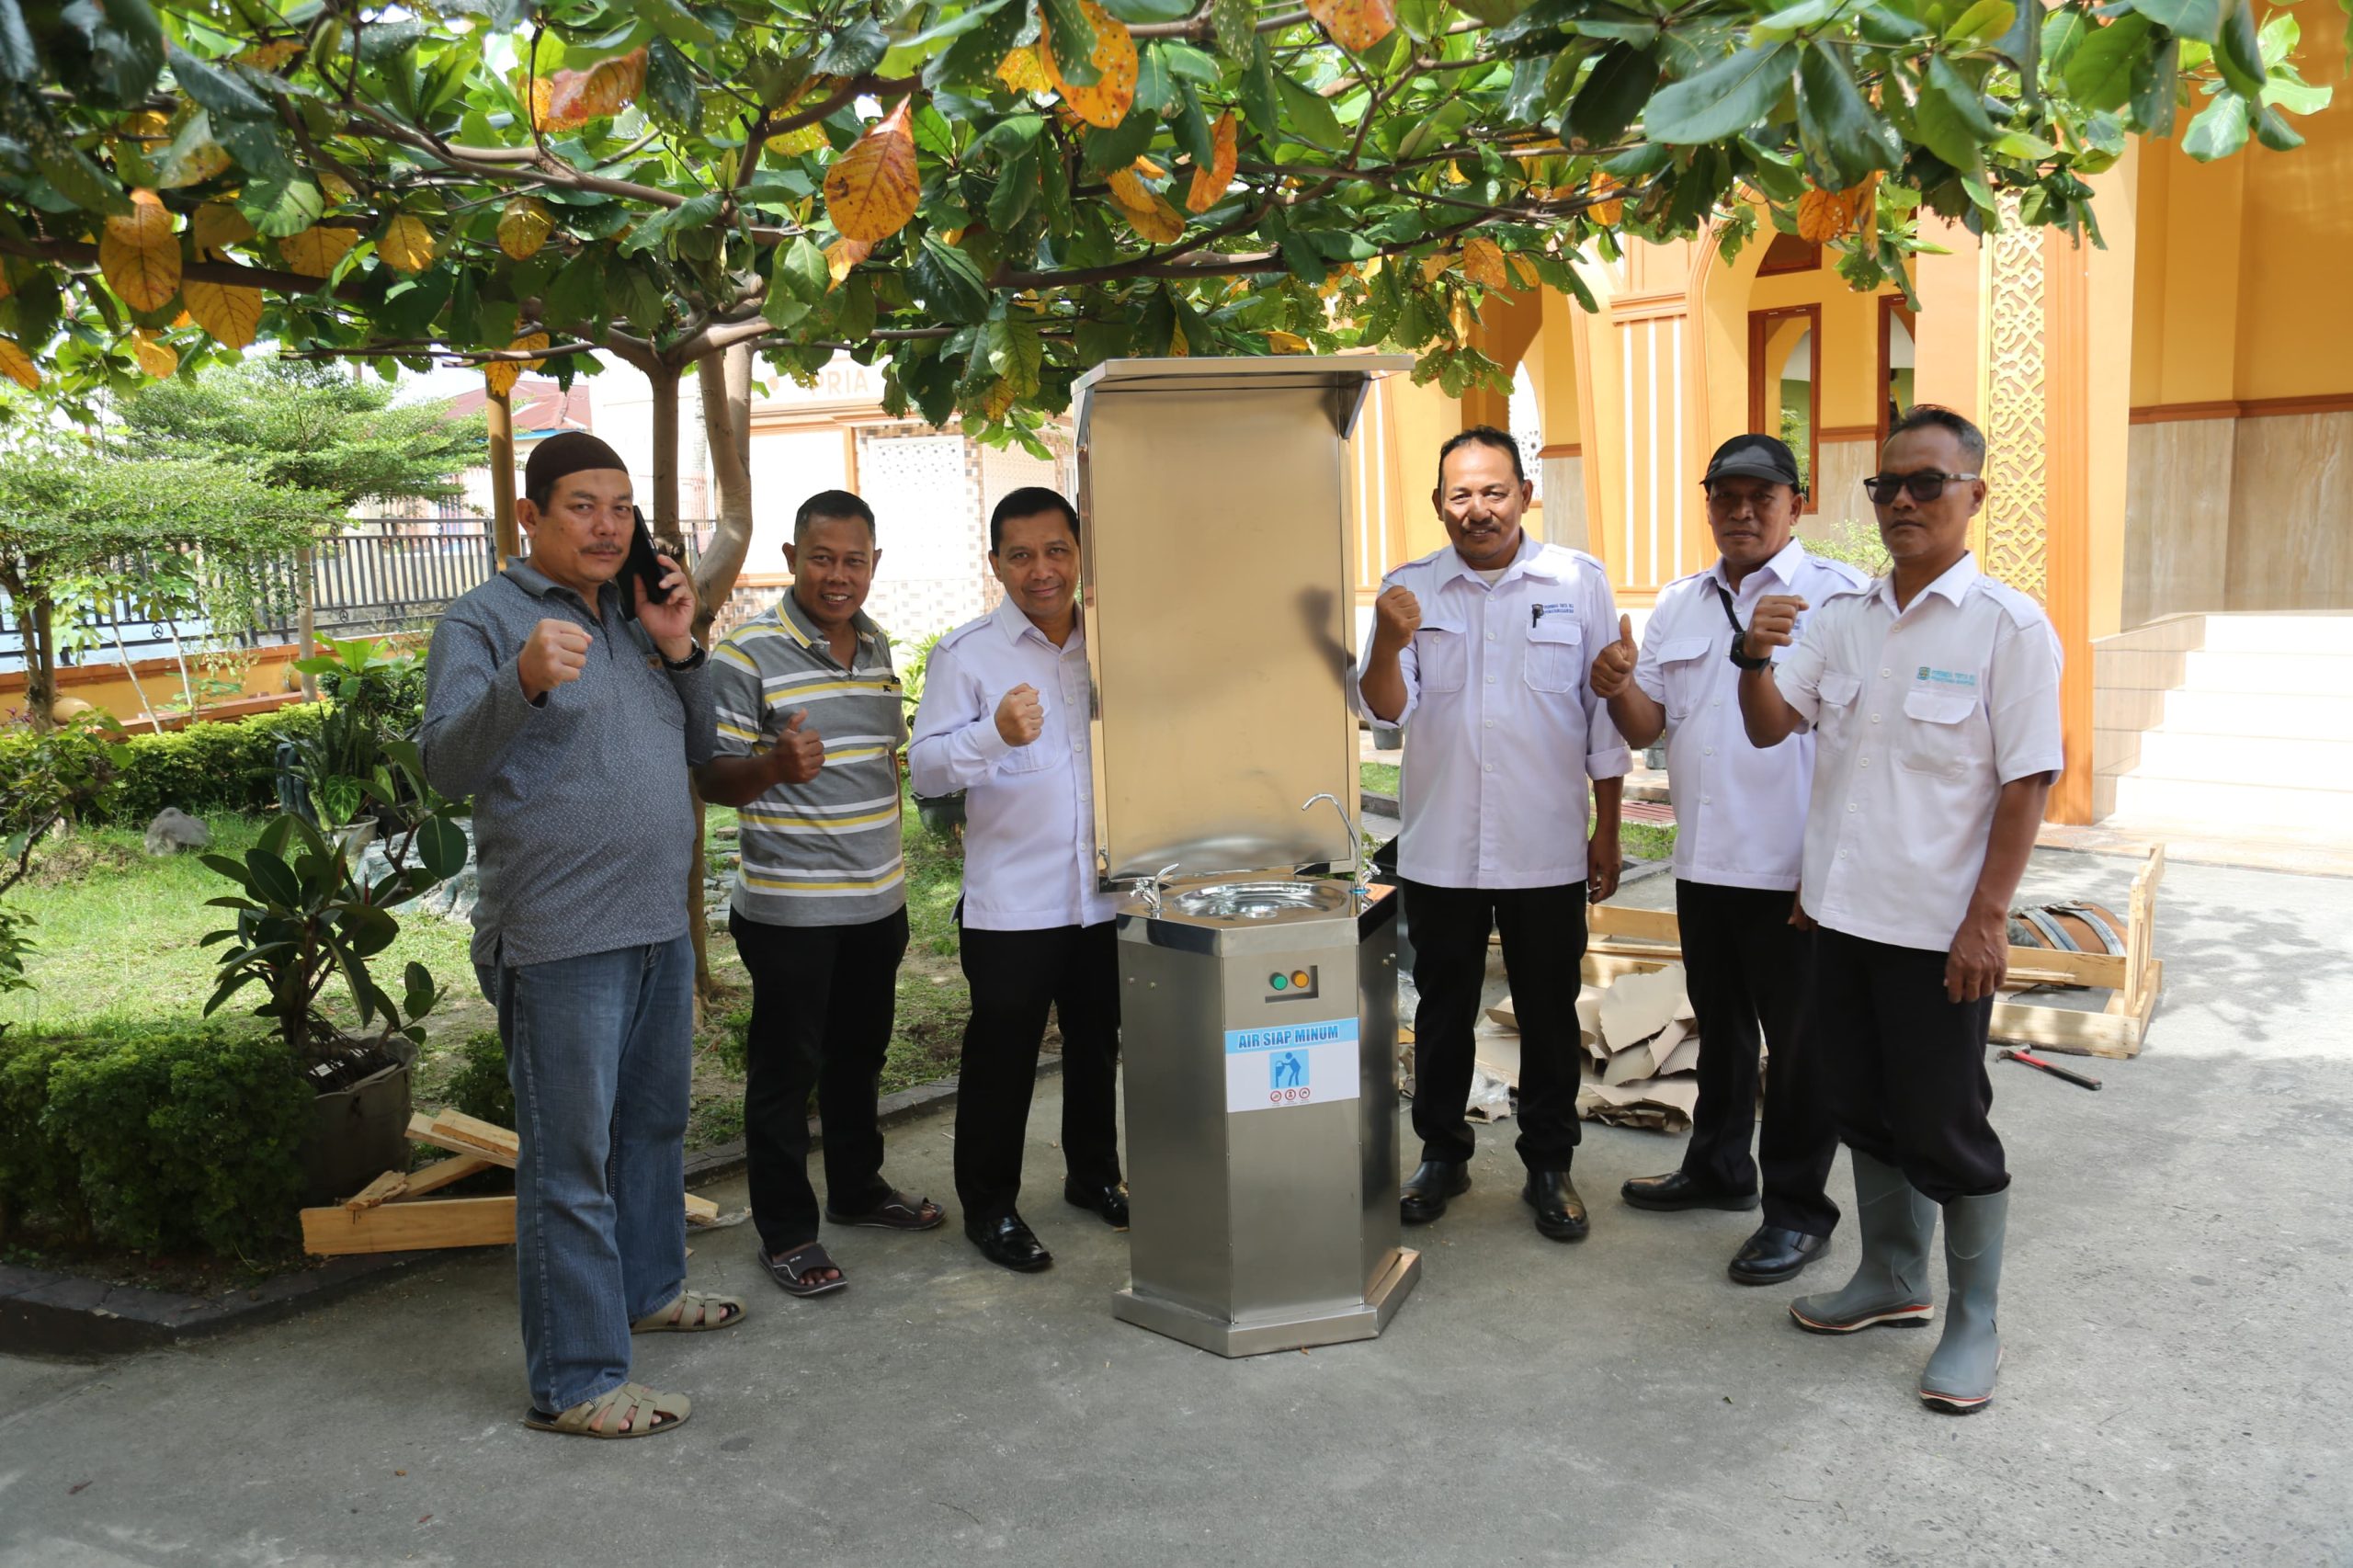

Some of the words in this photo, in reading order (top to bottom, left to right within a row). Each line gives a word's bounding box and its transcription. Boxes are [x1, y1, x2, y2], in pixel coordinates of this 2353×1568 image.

[1238, 1033, 1260, 1049] AIR
[1263, 1030, 1291, 1047] SIAP
[1294, 1025, 1338, 1043] MINUM
